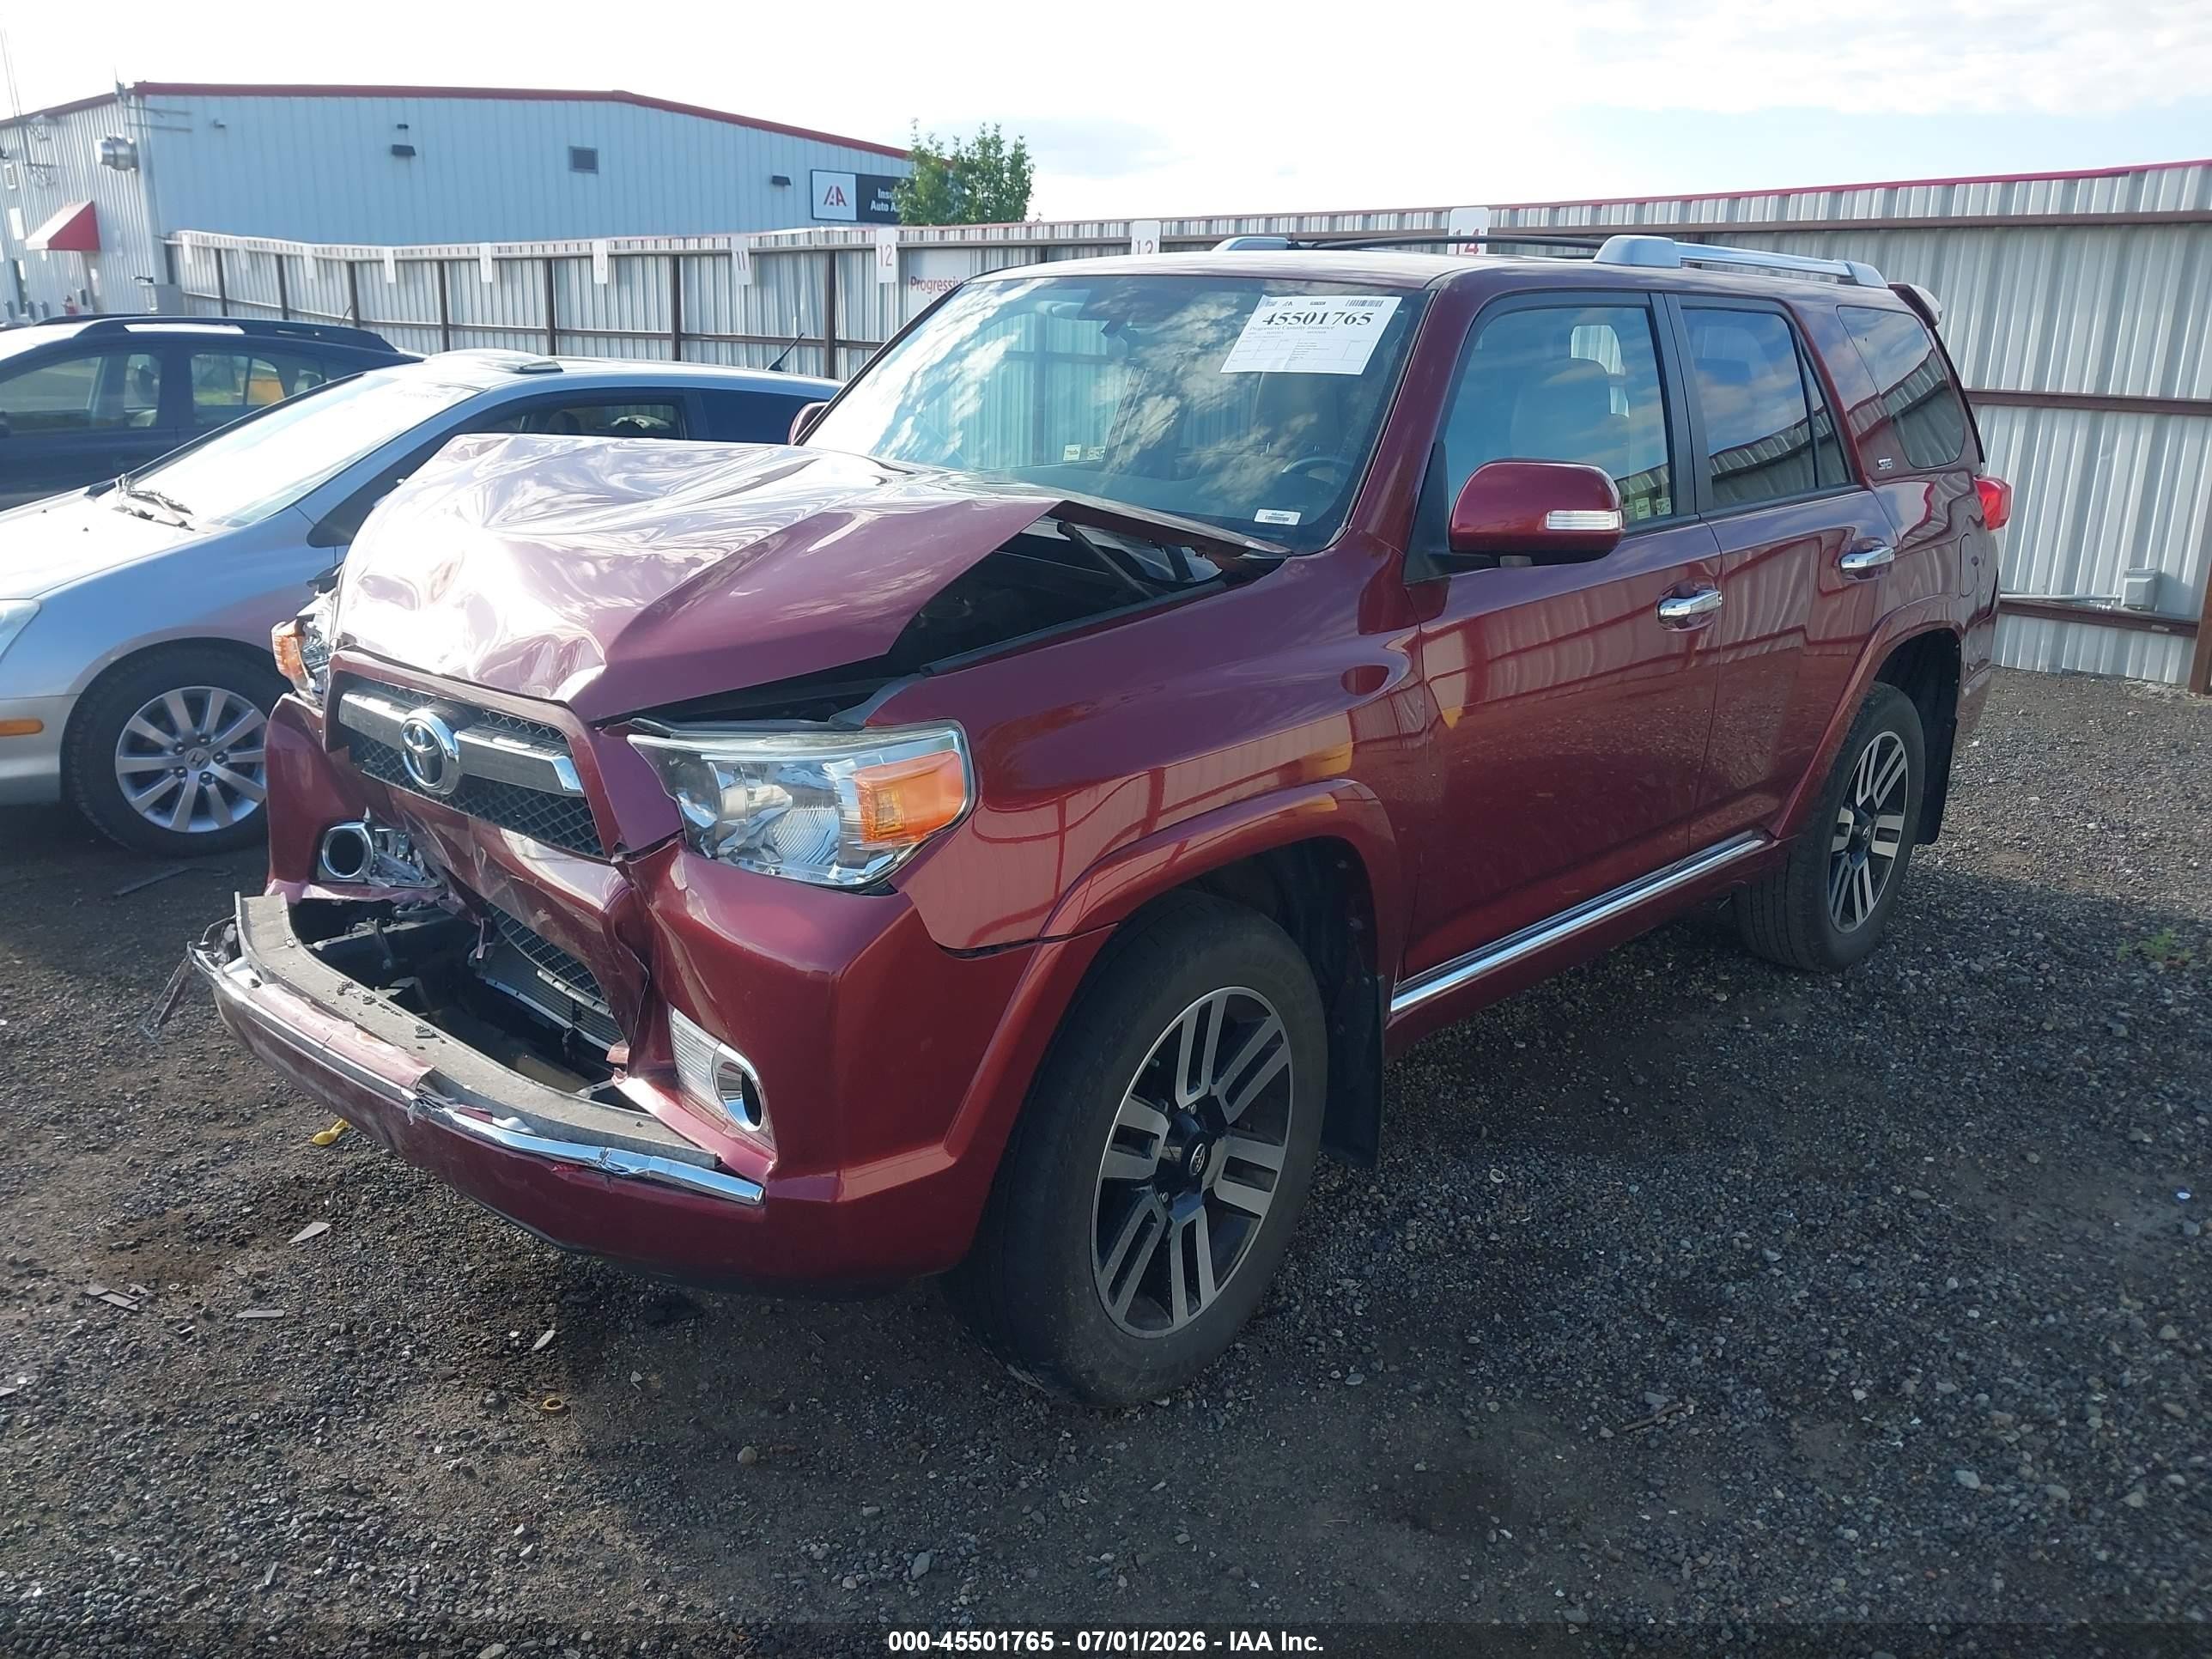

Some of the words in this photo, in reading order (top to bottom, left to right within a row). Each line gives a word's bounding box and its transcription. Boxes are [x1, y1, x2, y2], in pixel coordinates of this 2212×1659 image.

[870, 199, 890, 212] Auto
[878, 244, 893, 267] 12
[1261, 311, 1375, 326] 45501765
